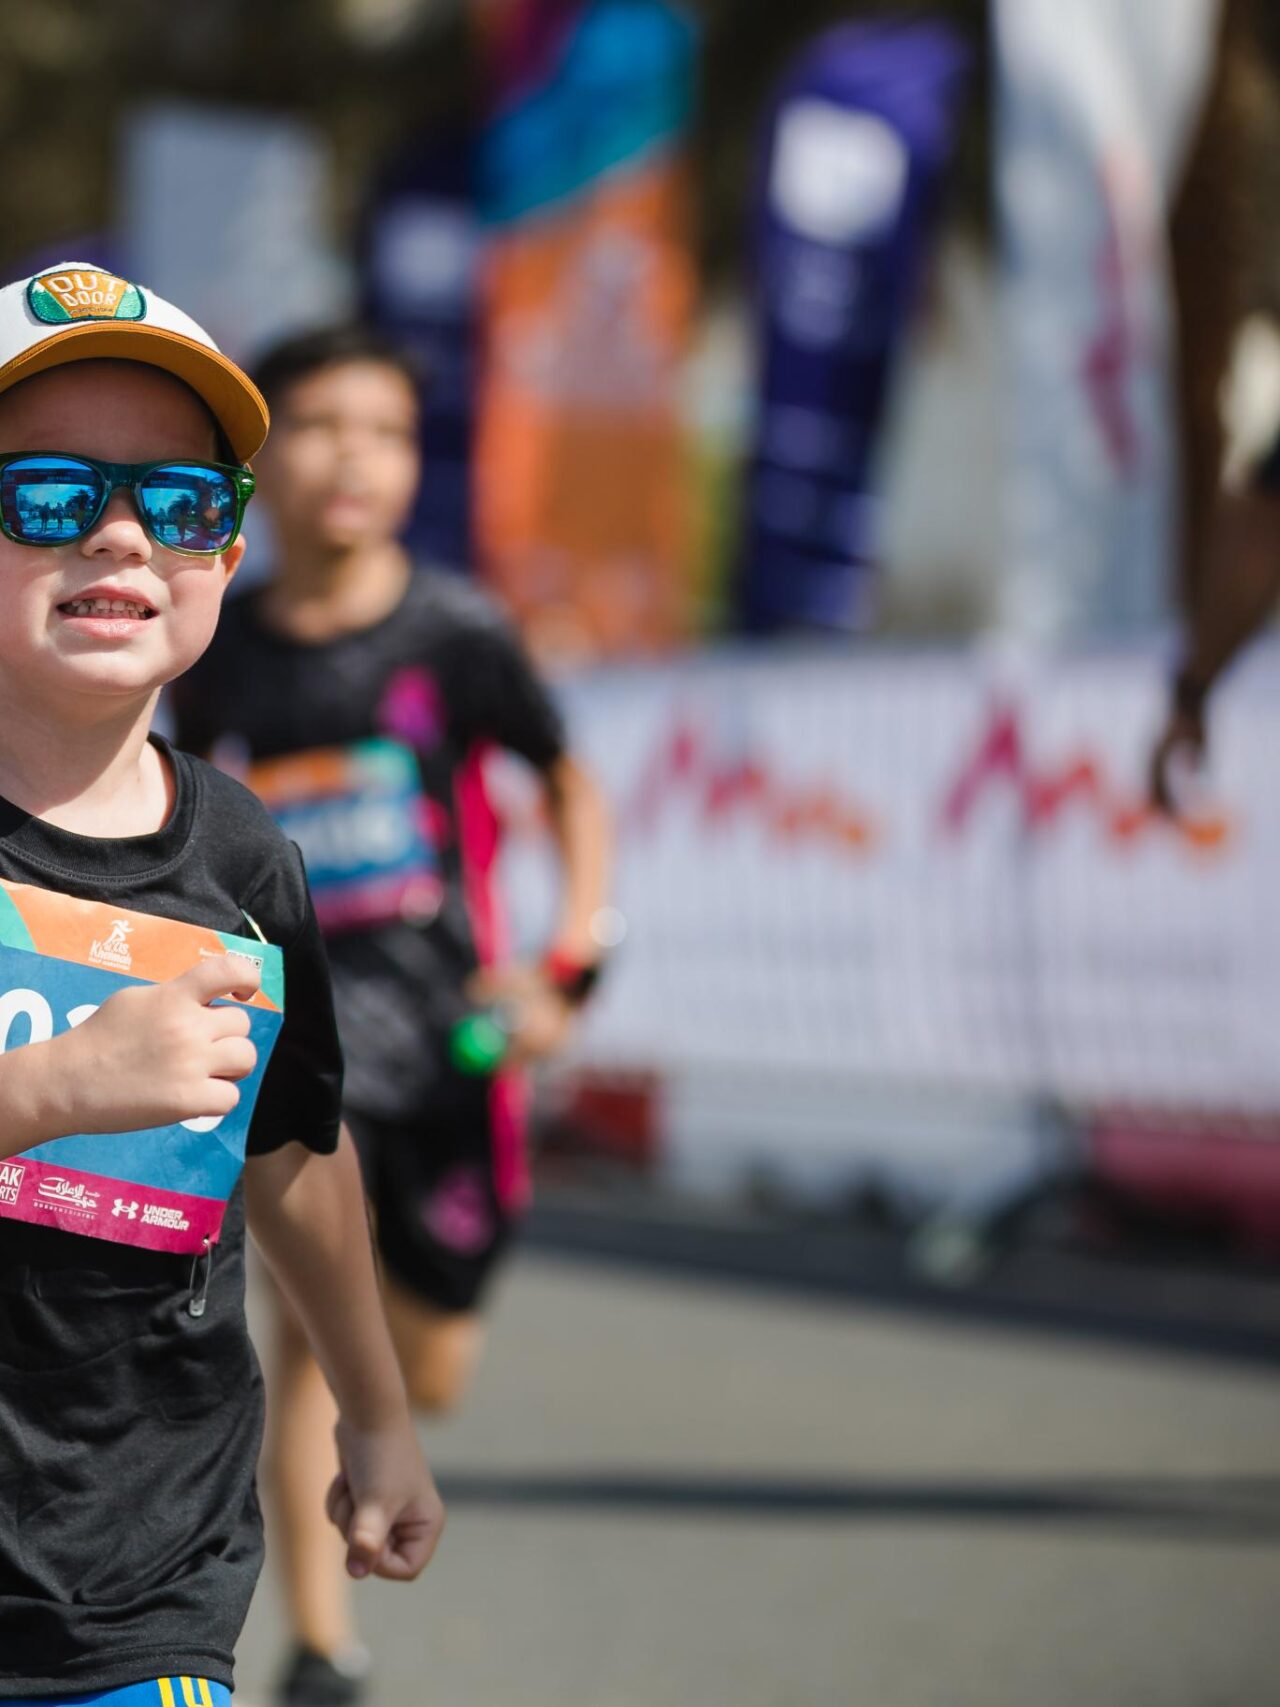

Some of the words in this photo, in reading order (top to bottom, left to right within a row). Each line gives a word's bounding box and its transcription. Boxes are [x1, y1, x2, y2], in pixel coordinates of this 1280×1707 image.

[47, 274, 124, 293] OUT
[61, 291, 117, 307] DOOR
[143, 1203, 184, 1221] UNDER
[140, 1214, 190, 1231] ARMOUR
